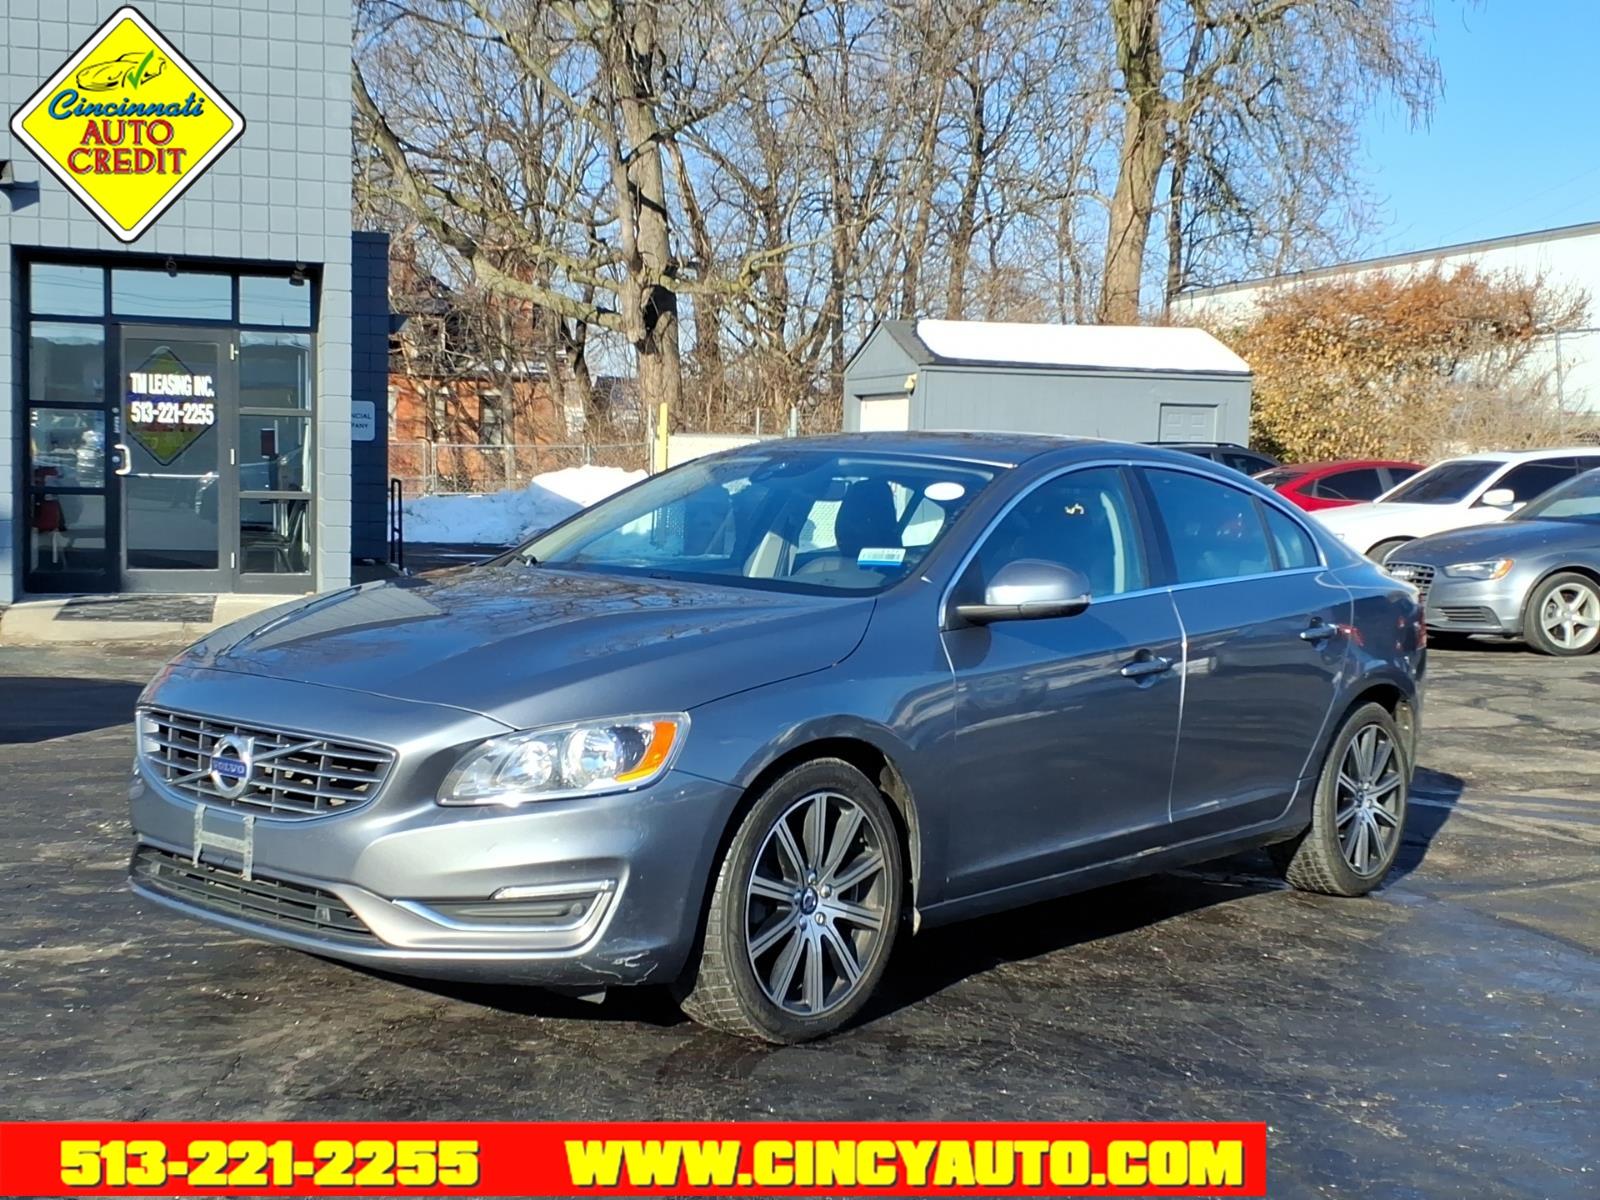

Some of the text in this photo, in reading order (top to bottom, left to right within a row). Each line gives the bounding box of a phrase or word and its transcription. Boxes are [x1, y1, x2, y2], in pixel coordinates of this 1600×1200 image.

[148, 373, 192, 396] LEASING
[193, 375, 215, 397] INC.
[130, 401, 215, 425] 513-221-2255
[213, 760, 245, 774] VOLVO
